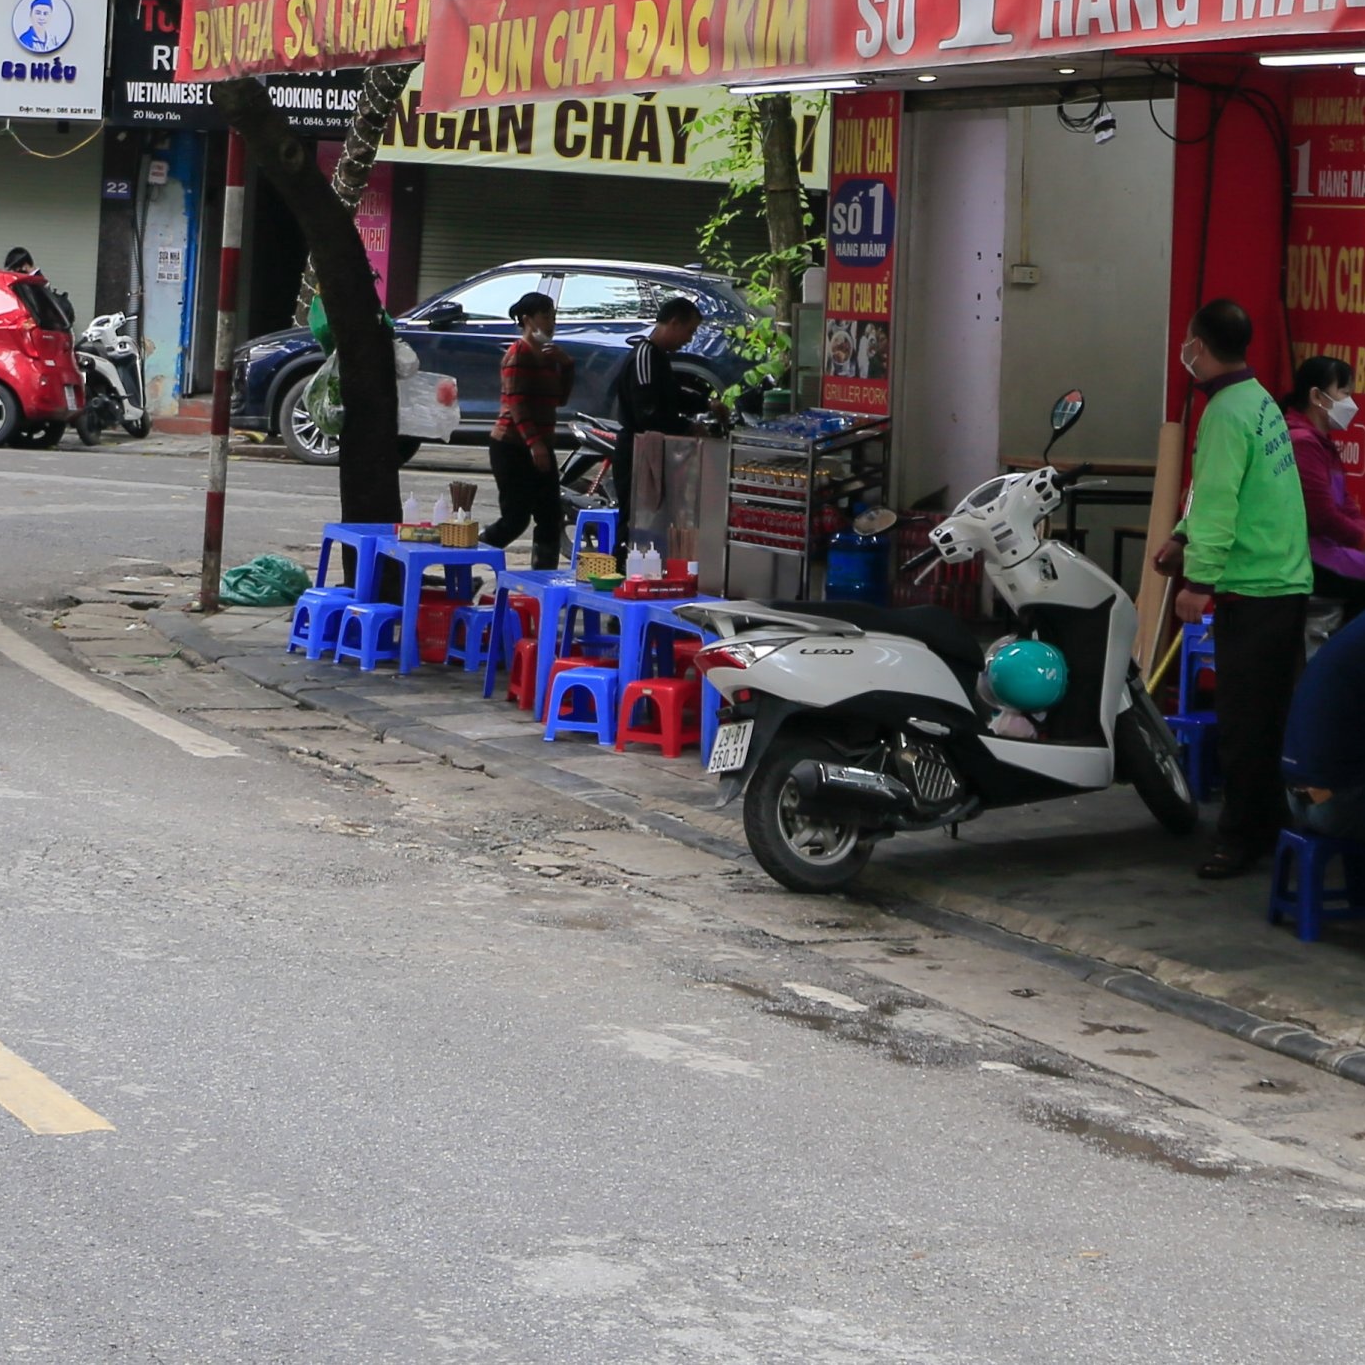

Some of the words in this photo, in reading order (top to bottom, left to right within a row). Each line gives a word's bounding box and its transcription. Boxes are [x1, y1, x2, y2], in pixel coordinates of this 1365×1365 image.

[126, 82, 205, 105] VIETNAMESE
[268, 85, 323, 110] COOKING
[133, 110, 145, 119] 20
[553, 92, 699, 165] CHÁY
[833, 106, 864, 175] BÚN
[865, 97, 894, 174] CHẢ
[1291, 139, 1315, 197] 1
[1318, 165, 1348, 198] HÀNG
[106, 182, 128, 194] 22
[832, 190, 865, 235] SỐ
[869, 182, 884, 235] 1
[835, 239, 860, 257] HÀNG
[860, 241, 887, 258] MÀNH
[1286, 225, 1331, 312] BÚN
[827, 281, 851, 312] NEM
[852, 282, 872, 313] CUA
[862, 387, 889, 406] PORK
